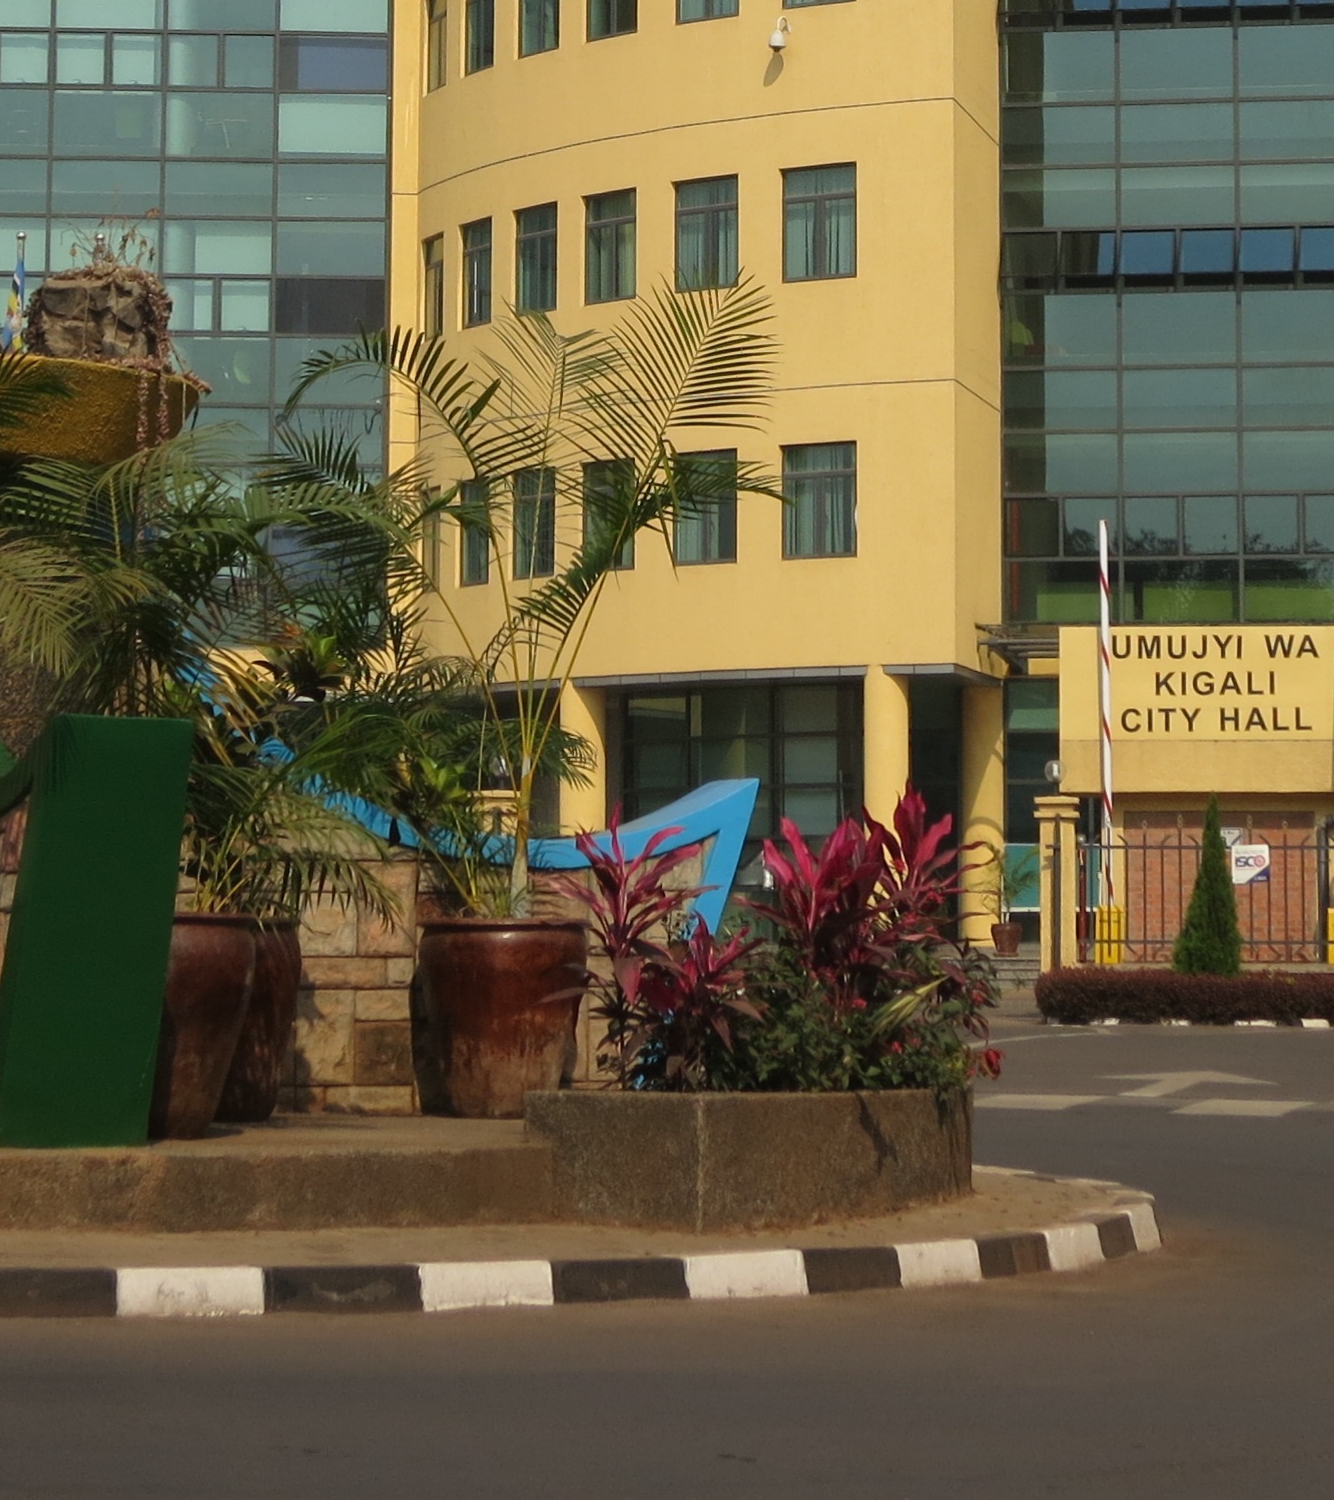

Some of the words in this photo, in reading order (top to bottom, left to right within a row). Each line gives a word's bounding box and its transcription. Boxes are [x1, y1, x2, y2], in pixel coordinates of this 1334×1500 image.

[1111, 634, 1243, 659] UMUJYI
[1264, 634, 1320, 659] WA
[1154, 671, 1276, 696] KIGALI
[1120, 708, 1200, 732] CITY
[1219, 707, 1313, 731] HALL
